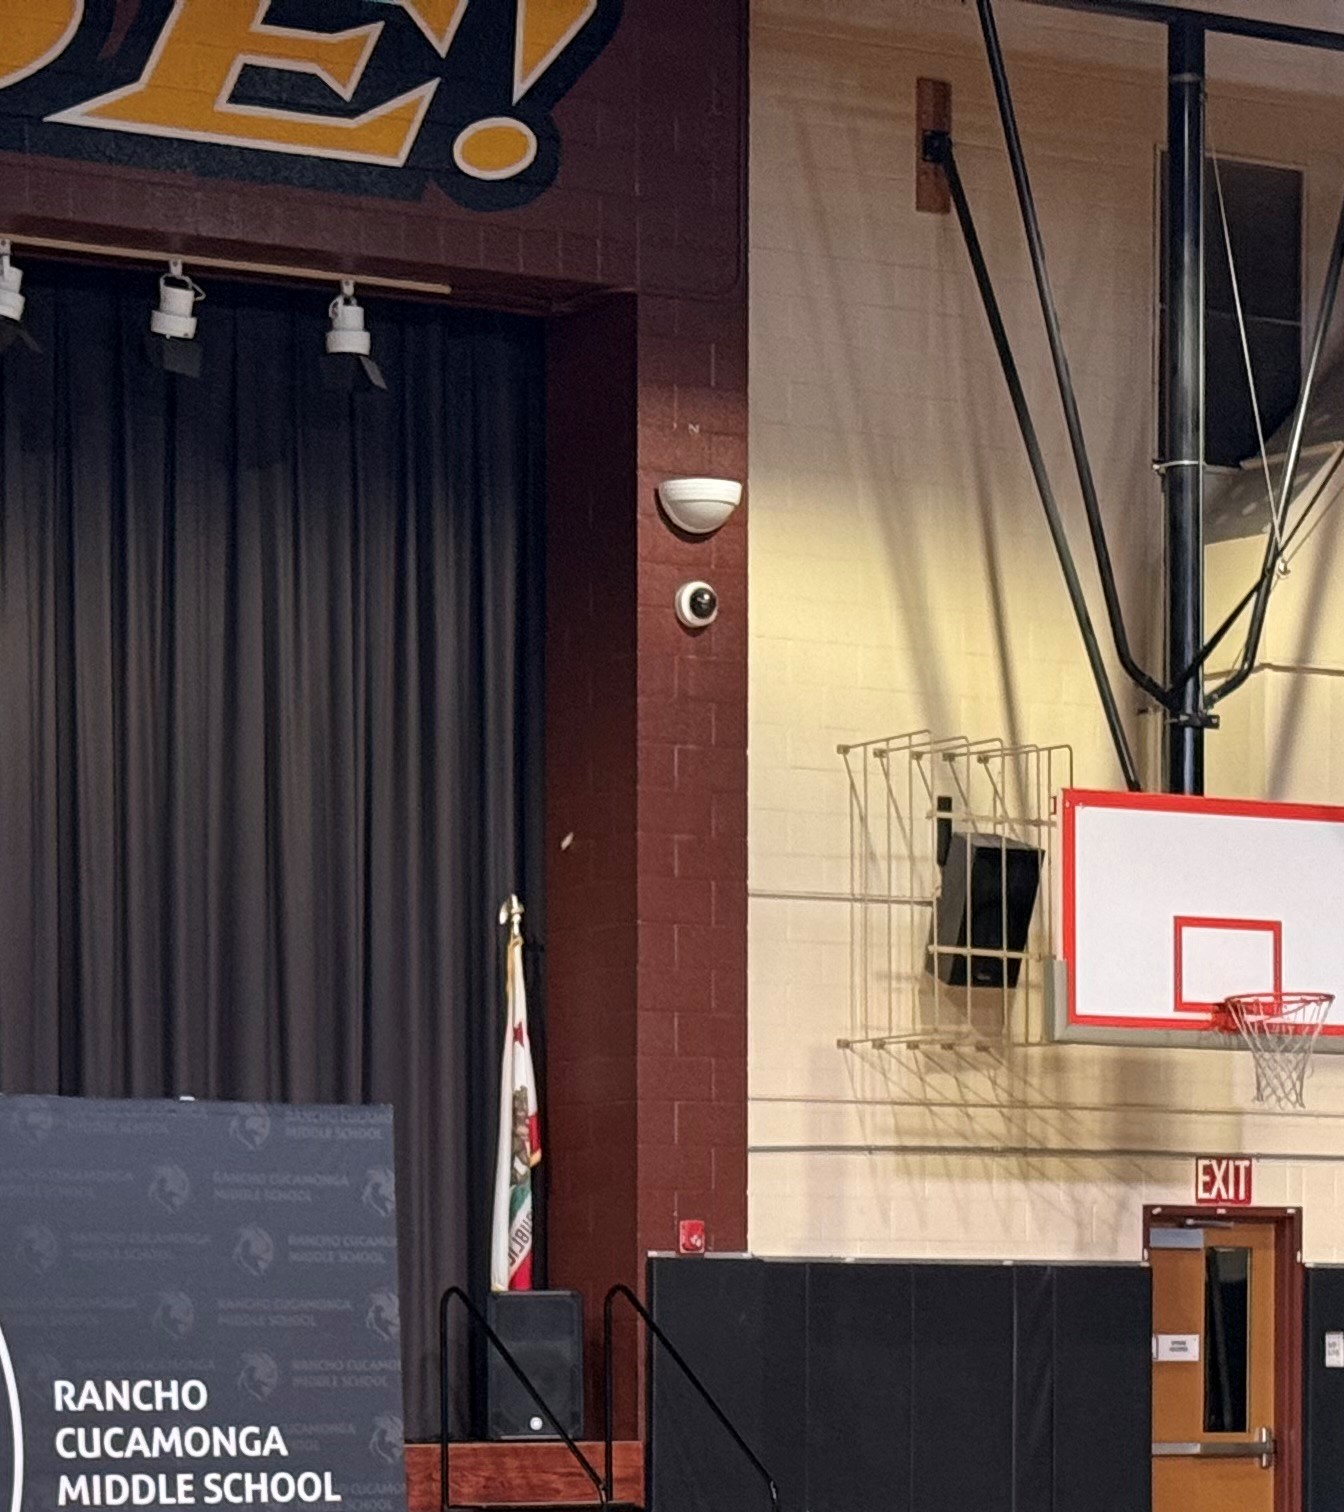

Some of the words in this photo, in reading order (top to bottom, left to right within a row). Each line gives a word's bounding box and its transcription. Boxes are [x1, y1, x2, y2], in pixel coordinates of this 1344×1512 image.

[1197, 1159, 1251, 1200] EXIT
[54, 1380, 208, 1411] RANCHO
[56, 1426, 289, 1458] CUCAMONGA
[58, 1473, 196, 1506] MIDDLE
[204, 1471, 342, 1504] SCHOOL
